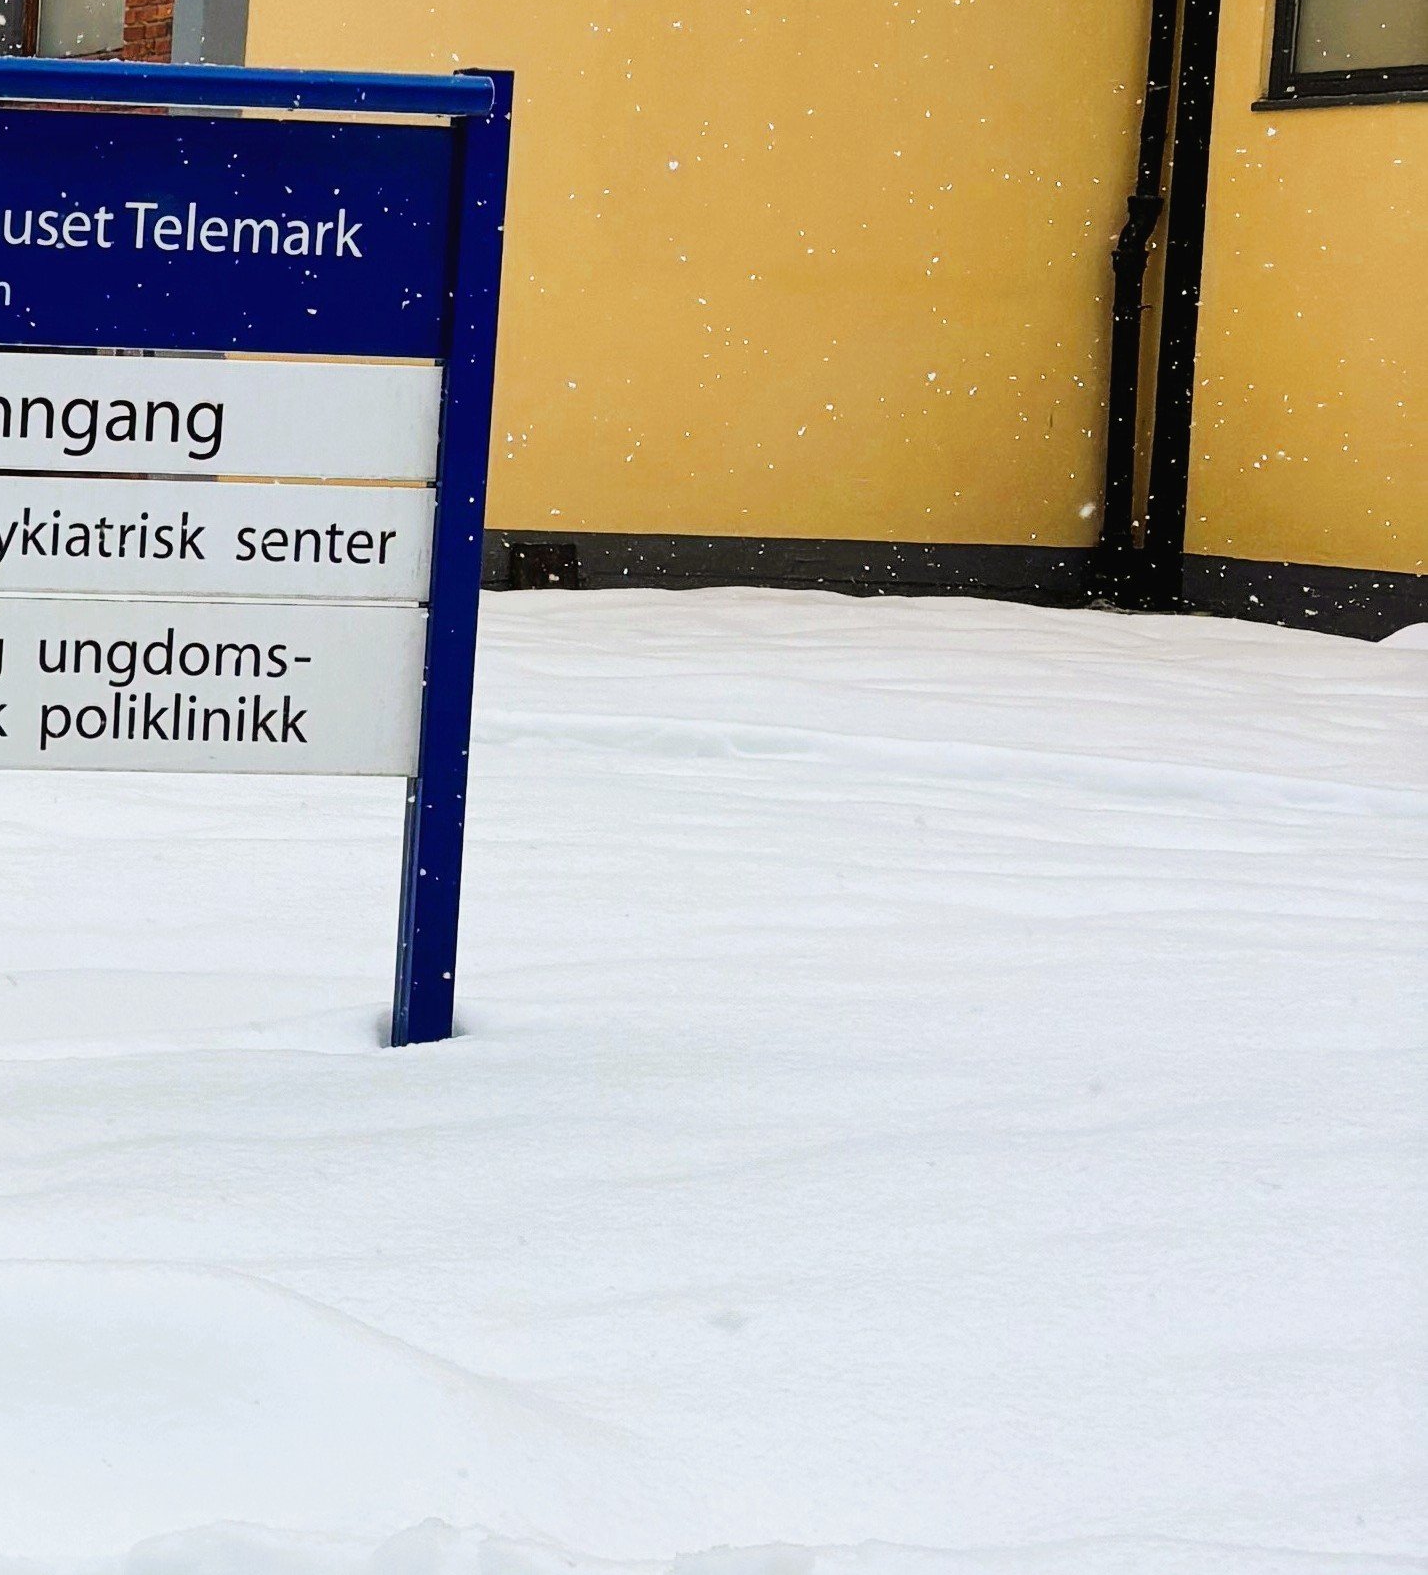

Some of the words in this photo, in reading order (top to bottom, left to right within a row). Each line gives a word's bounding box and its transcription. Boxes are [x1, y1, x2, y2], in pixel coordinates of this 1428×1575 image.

[127, 201, 363, 258] Telemark
[235, 523, 397, 565] senter
[39, 627, 312, 688] ungdoms-
[40, 691, 308, 751] poliklinikk
